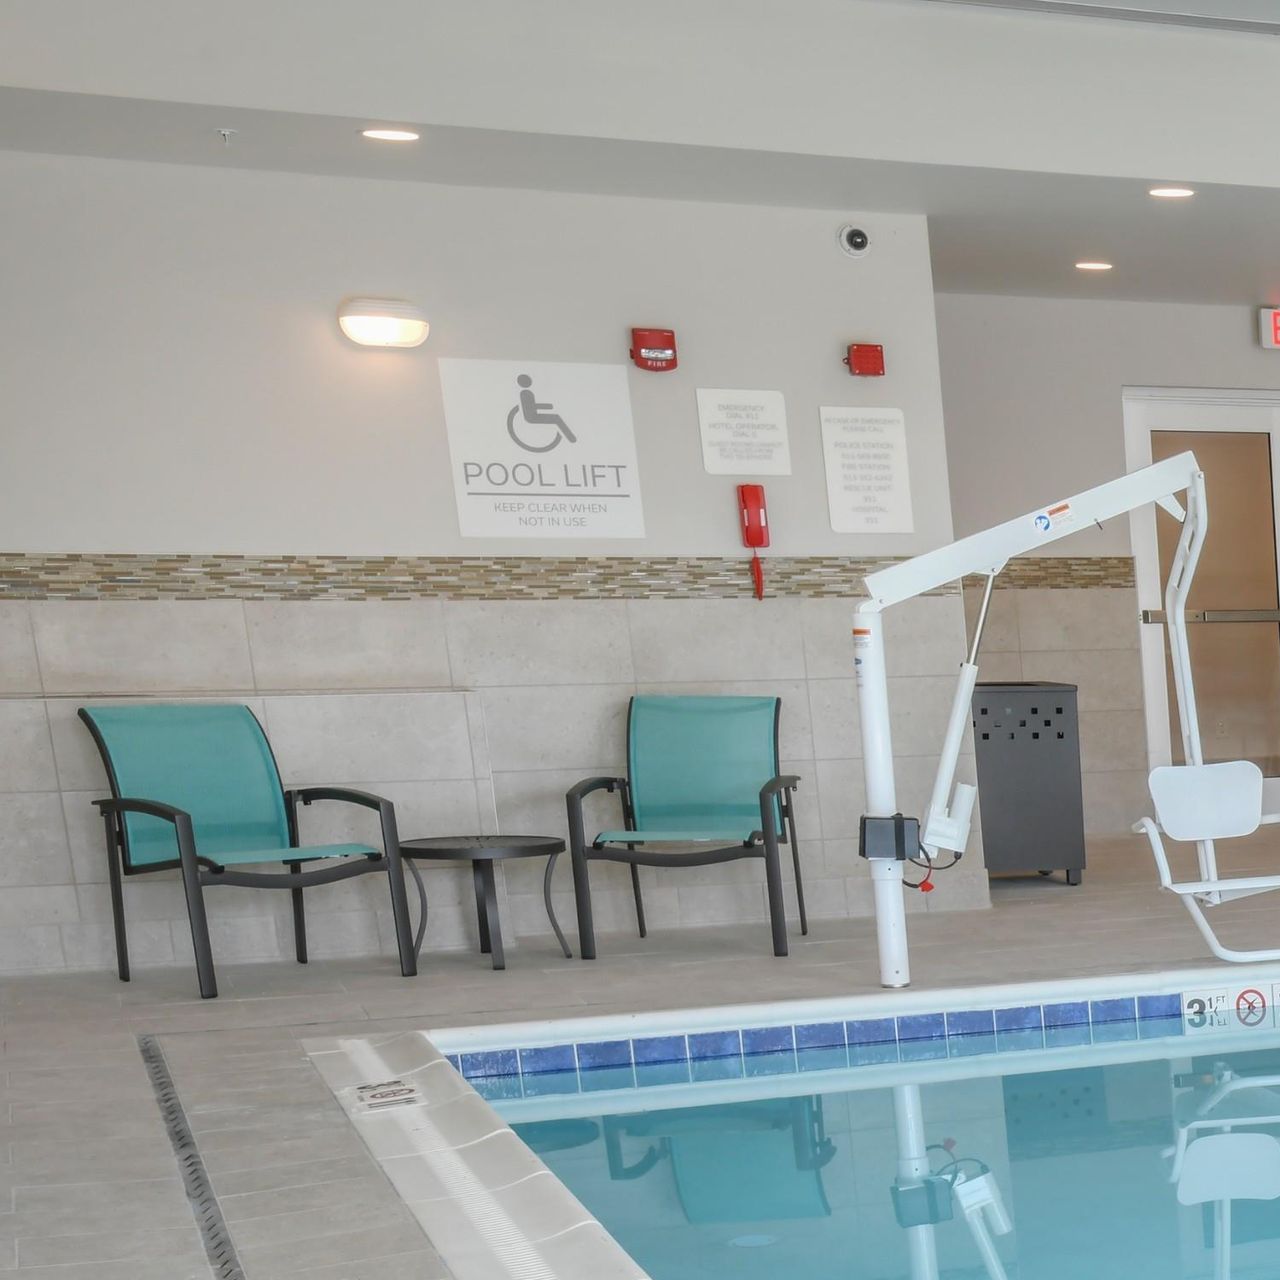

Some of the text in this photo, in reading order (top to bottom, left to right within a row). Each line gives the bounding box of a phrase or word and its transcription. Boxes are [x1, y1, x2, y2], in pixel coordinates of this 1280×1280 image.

[463, 462, 627, 488] POOL LIFT
[494, 502, 608, 514] KEEP CLEAR WHEN
[518, 516, 587, 527] NOT IN USE
